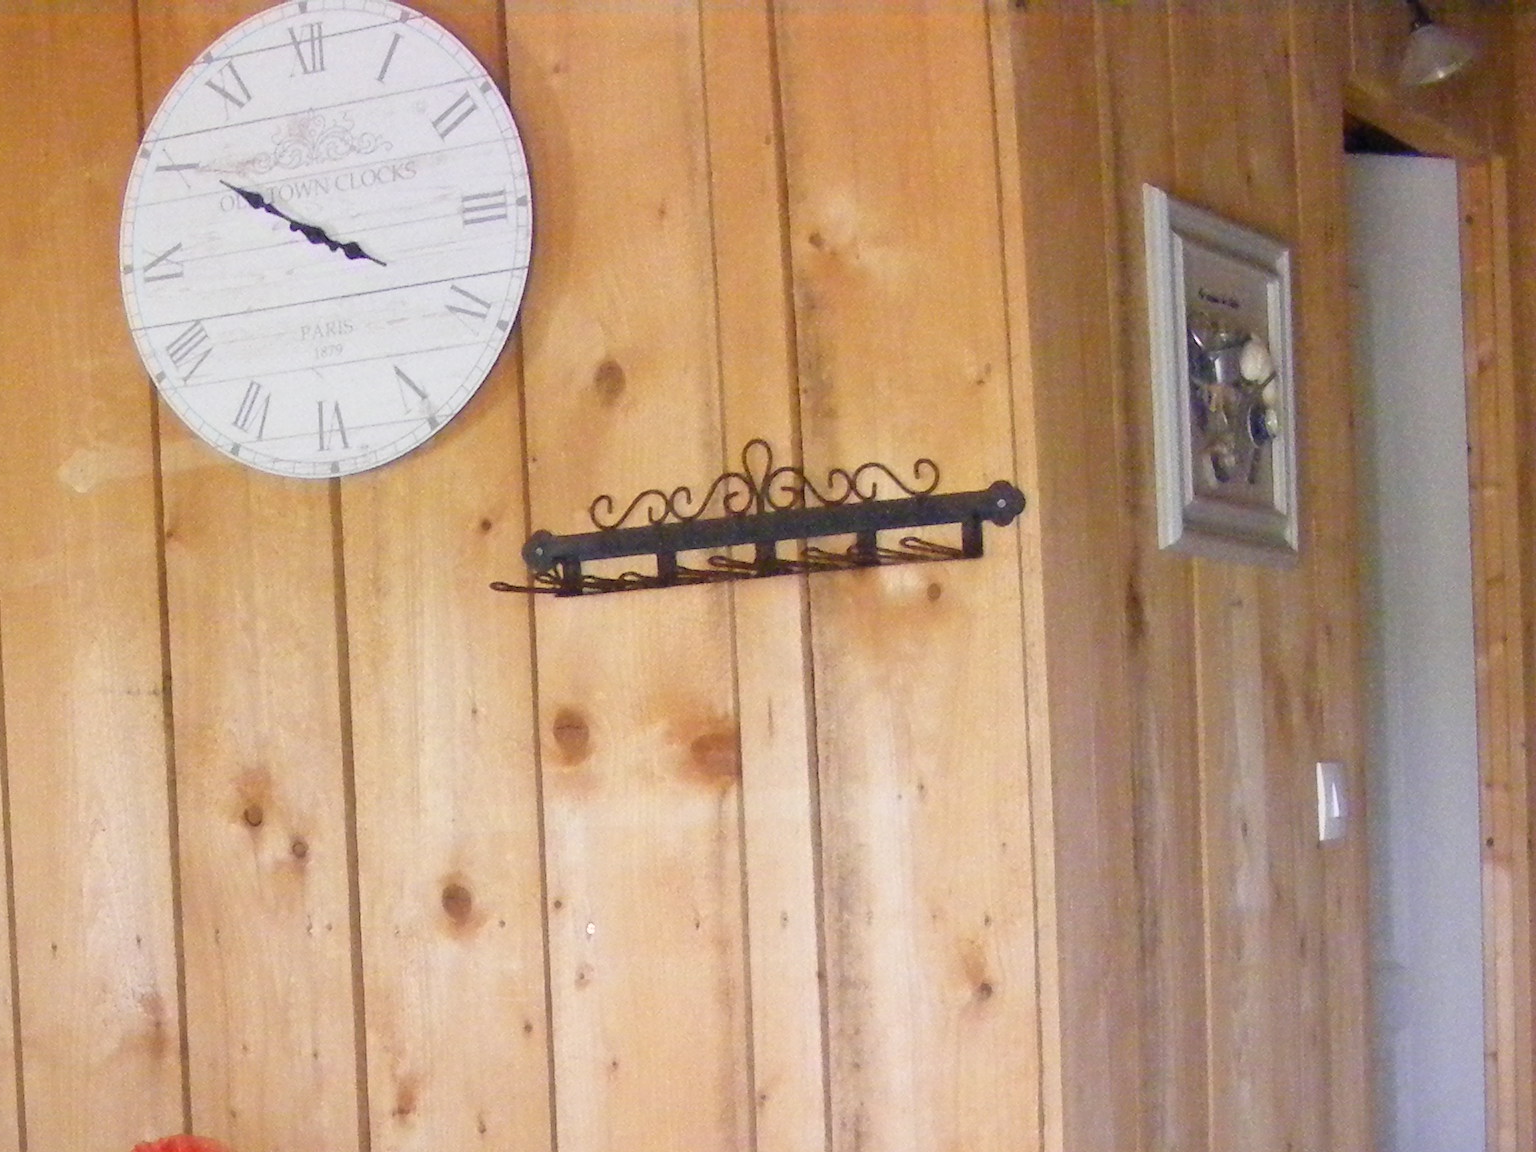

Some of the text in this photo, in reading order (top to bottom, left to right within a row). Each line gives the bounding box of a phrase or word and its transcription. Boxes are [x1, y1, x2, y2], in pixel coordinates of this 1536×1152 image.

[287, 22, 325, 77] XII
[205, 60, 252, 121] XI
[432, 91, 479, 141] II
[266, 176, 329, 205] TOWN
[334, 161, 417, 192] CLOCKS
[462, 186, 507, 227] III
[300, 319, 354, 341] PARIS
[314, 343, 344, 360] 1879
